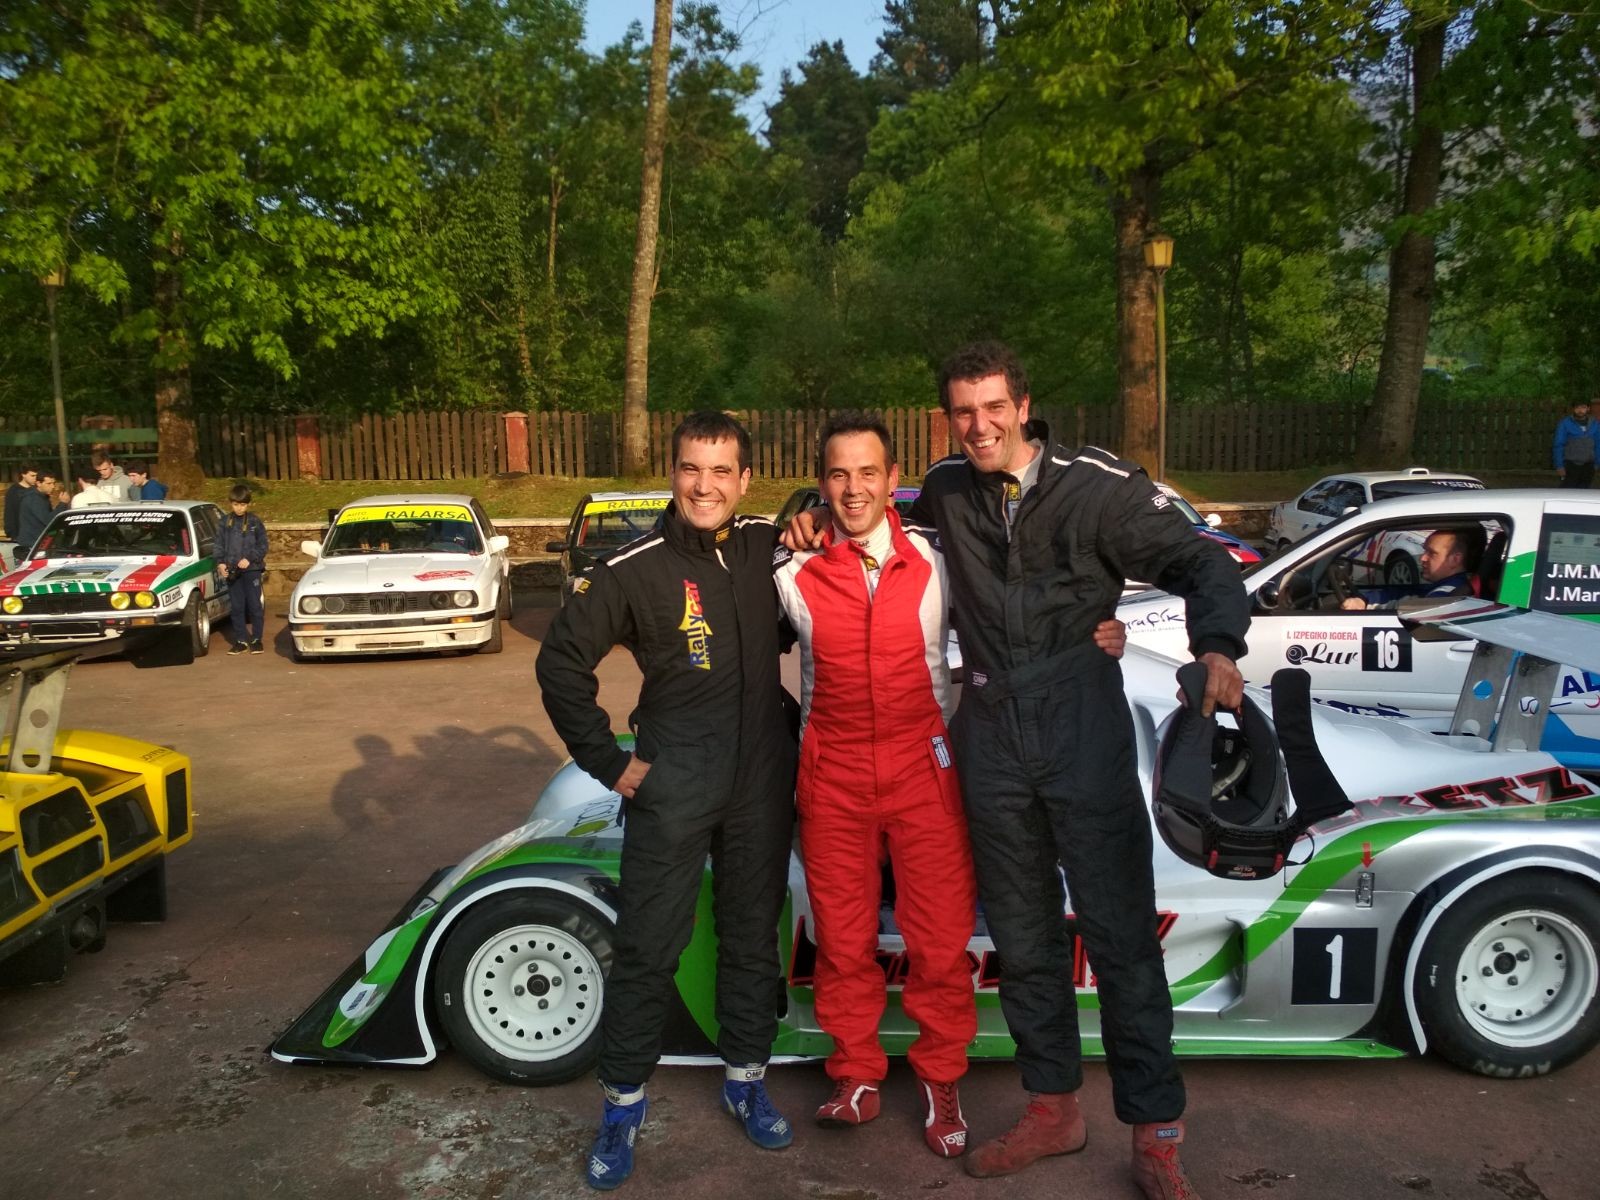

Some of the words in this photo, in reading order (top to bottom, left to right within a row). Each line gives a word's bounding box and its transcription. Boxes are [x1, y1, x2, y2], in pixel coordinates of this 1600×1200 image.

[384, 510, 468, 521] RALARSA
[683, 578, 706, 669] Rallycar
[1293, 631, 1328, 640] IZPEGIKO
[1329, 632, 1358, 641] IGOERA
[1301, 642, 1359, 665] Lur
[1373, 630, 1400, 669] 16
[1325, 934, 1344, 999] 1
[745, 1070, 763, 1079] OMP
